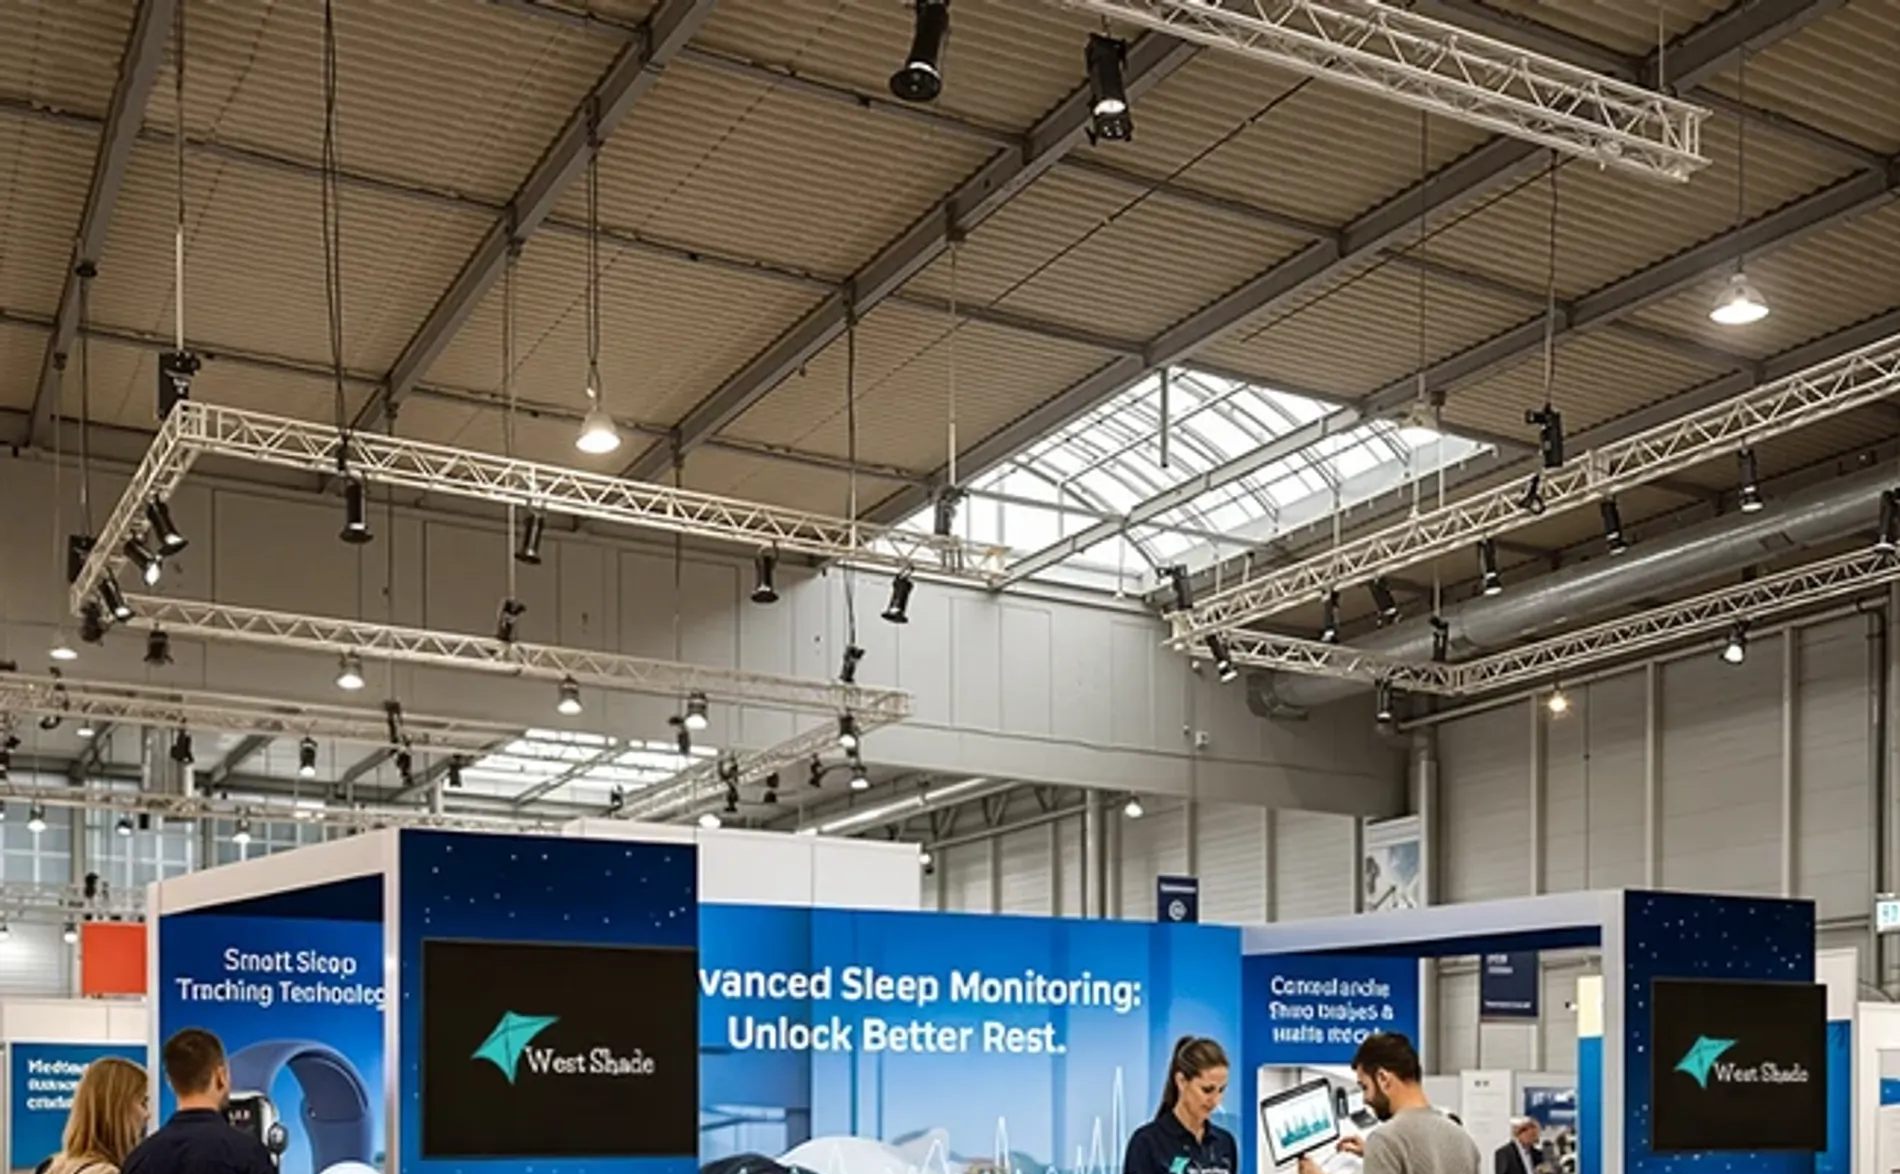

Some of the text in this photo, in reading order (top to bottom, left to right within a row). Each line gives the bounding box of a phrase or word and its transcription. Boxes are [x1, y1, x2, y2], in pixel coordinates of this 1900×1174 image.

[841, 966, 938, 1007] Sleep
[950, 969, 1142, 1014] Monitoring:
[727, 1015, 1067, 1054] Unlock Better Rest.
[525, 1046, 655, 1076] West Shade
